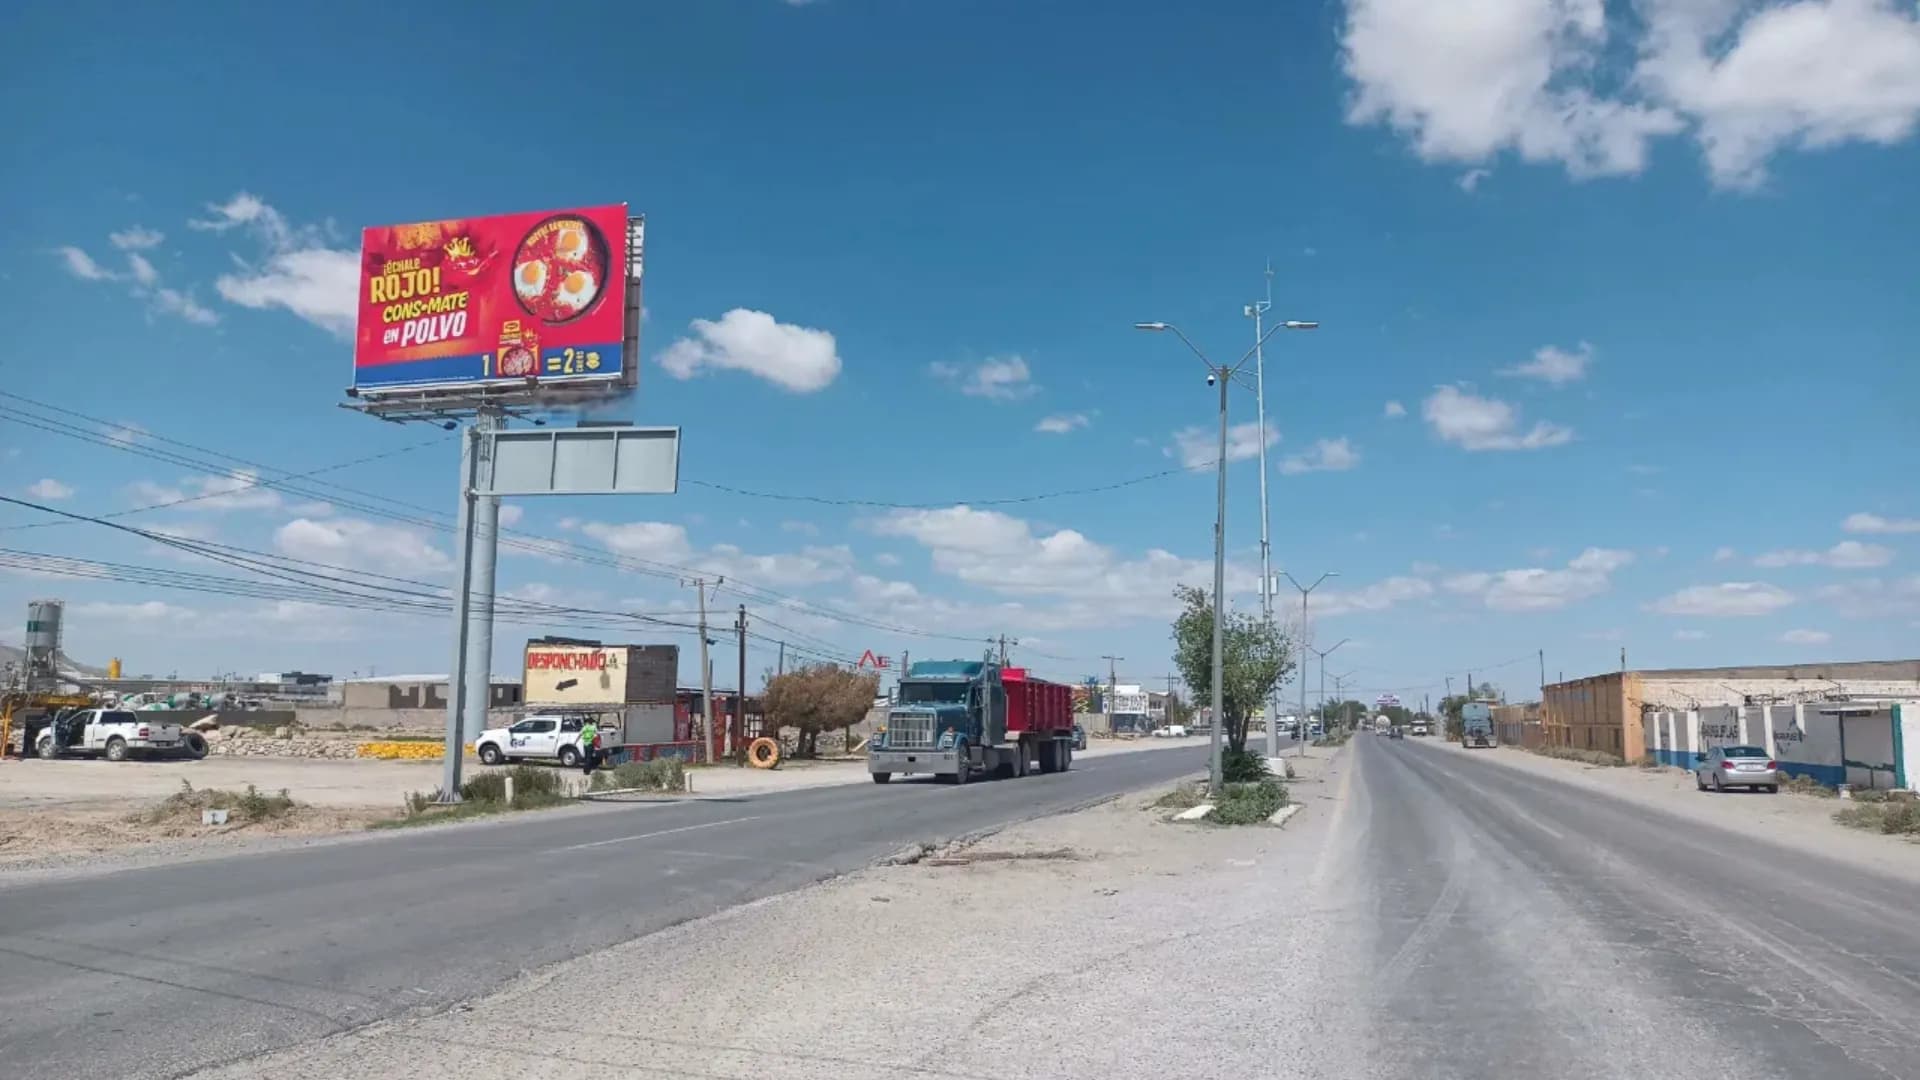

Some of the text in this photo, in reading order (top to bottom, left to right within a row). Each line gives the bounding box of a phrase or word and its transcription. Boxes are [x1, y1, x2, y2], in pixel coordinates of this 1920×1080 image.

[370, 266, 440, 304] ROJO!
[400, 310, 467, 347] POLVO
[482, 354, 490, 377] 1
